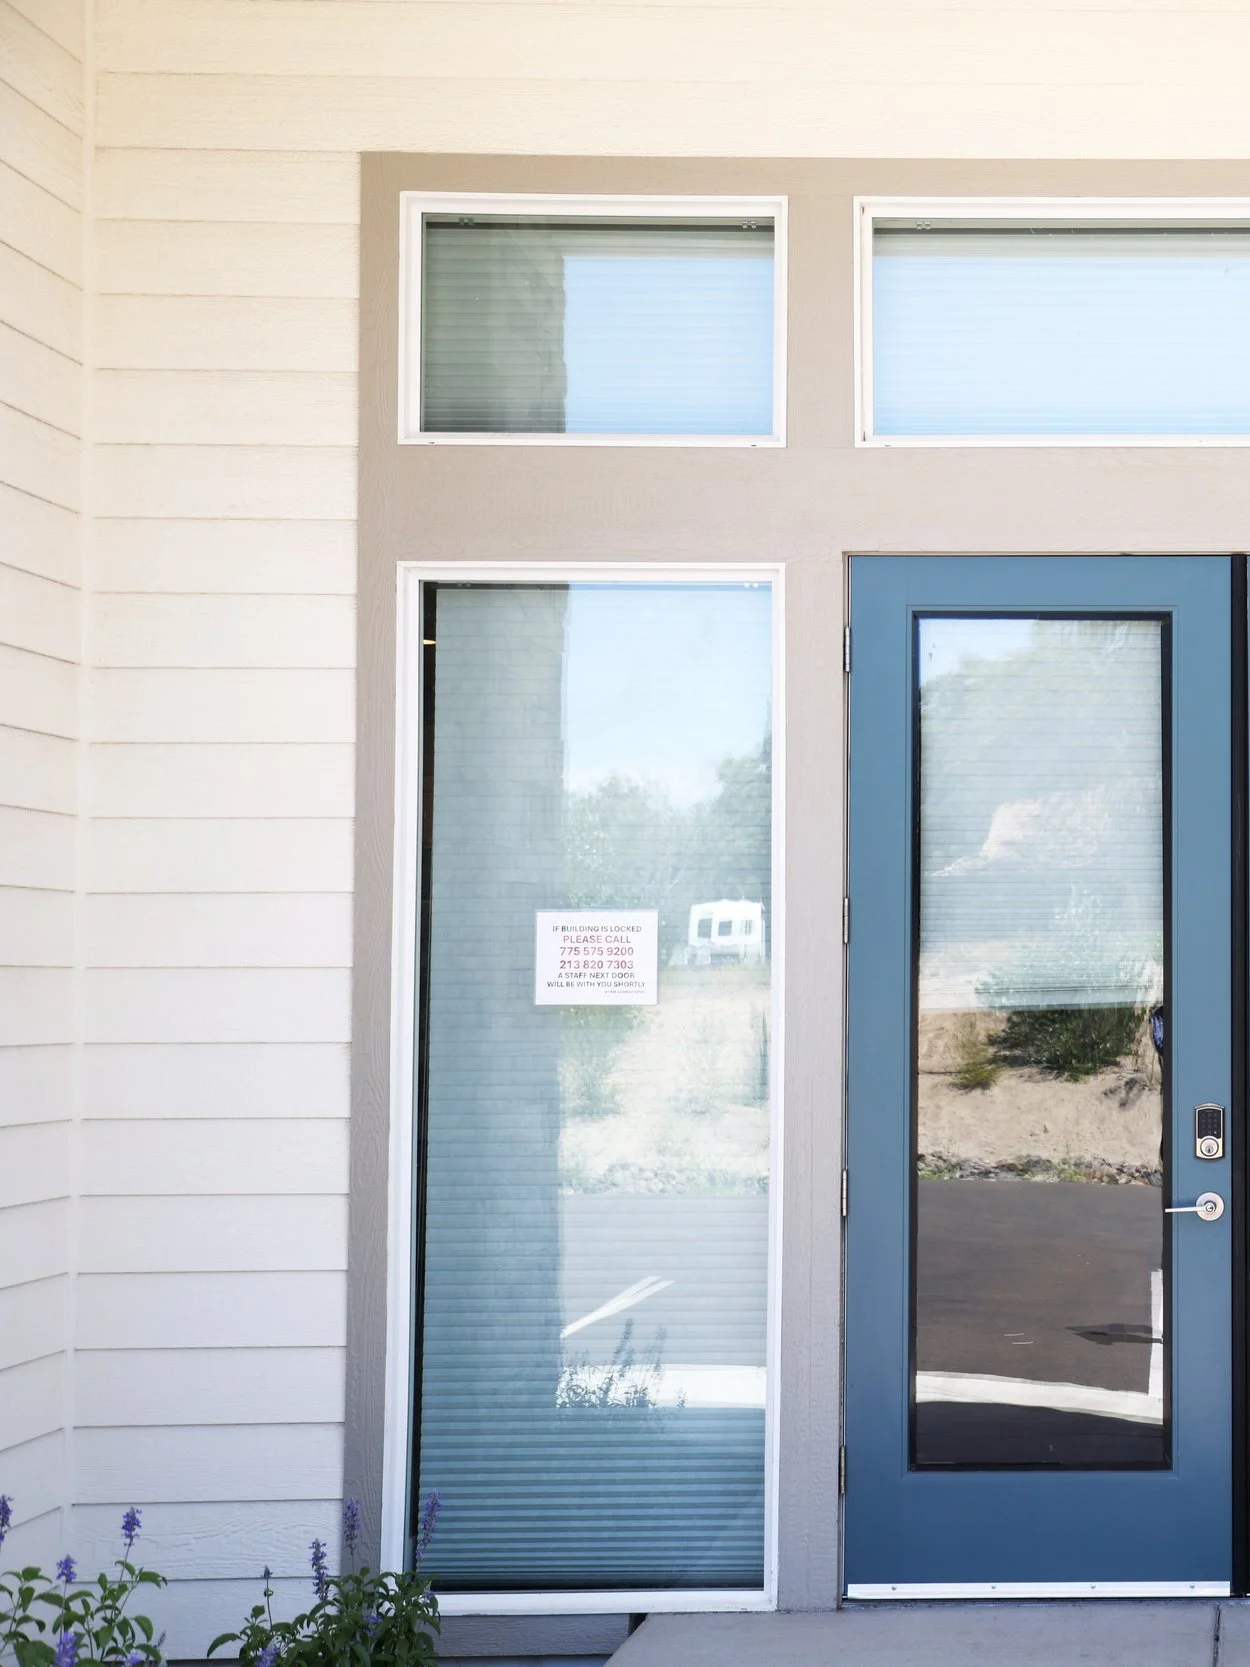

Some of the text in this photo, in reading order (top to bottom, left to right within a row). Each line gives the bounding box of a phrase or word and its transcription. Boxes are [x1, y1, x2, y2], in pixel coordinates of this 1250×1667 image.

[563, 935, 631, 944] PLEASE CALL
[560, 946, 634, 956] 775 575 9200
[560, 960, 634, 969] 213 820 7303
